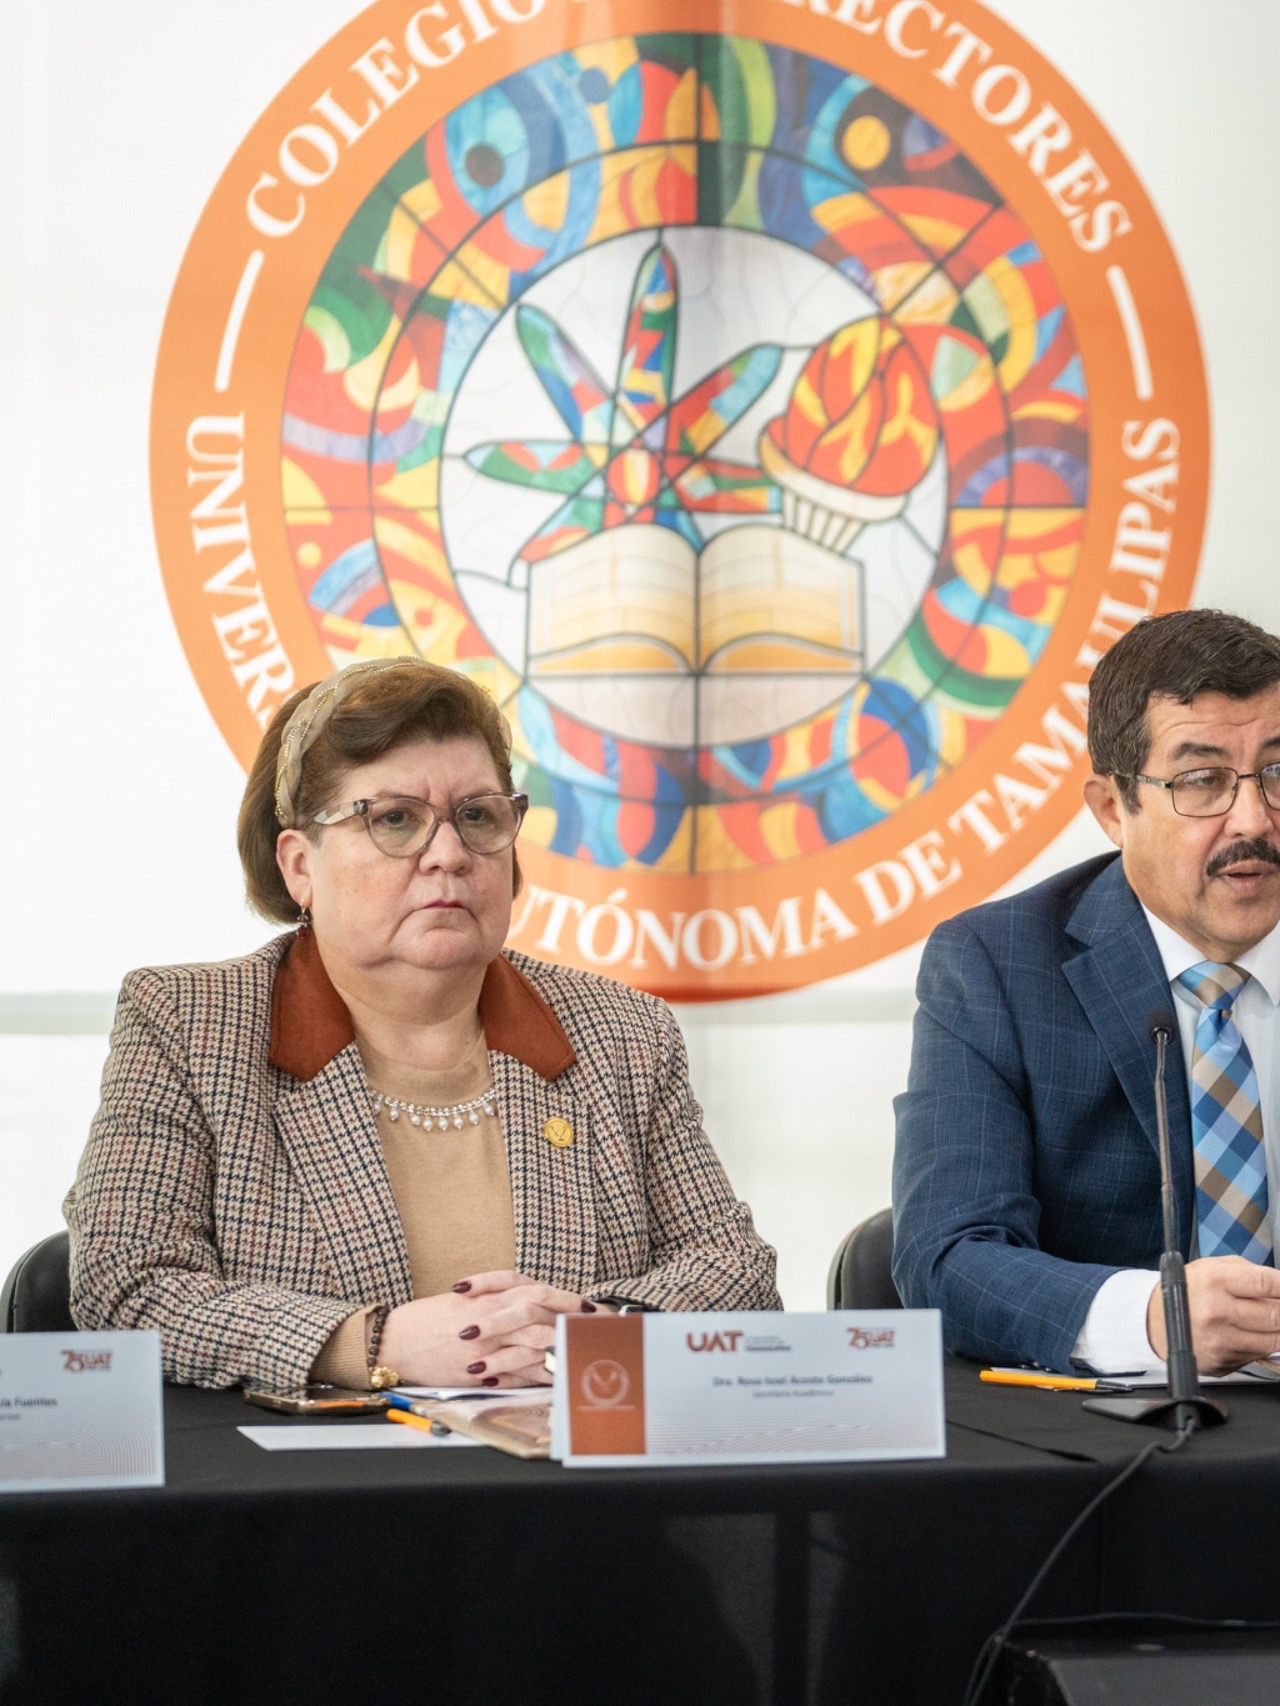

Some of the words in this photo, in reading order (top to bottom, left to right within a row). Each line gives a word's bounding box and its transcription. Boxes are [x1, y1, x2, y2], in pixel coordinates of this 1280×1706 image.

[784, 0, 1133, 253] ECTORES
[186, 411, 296, 729] UNIVER
[506, 881, 859, 970] TÓNOMA
[853, 836, 962, 926] DE
[686, 1330, 744, 1352] UAT
